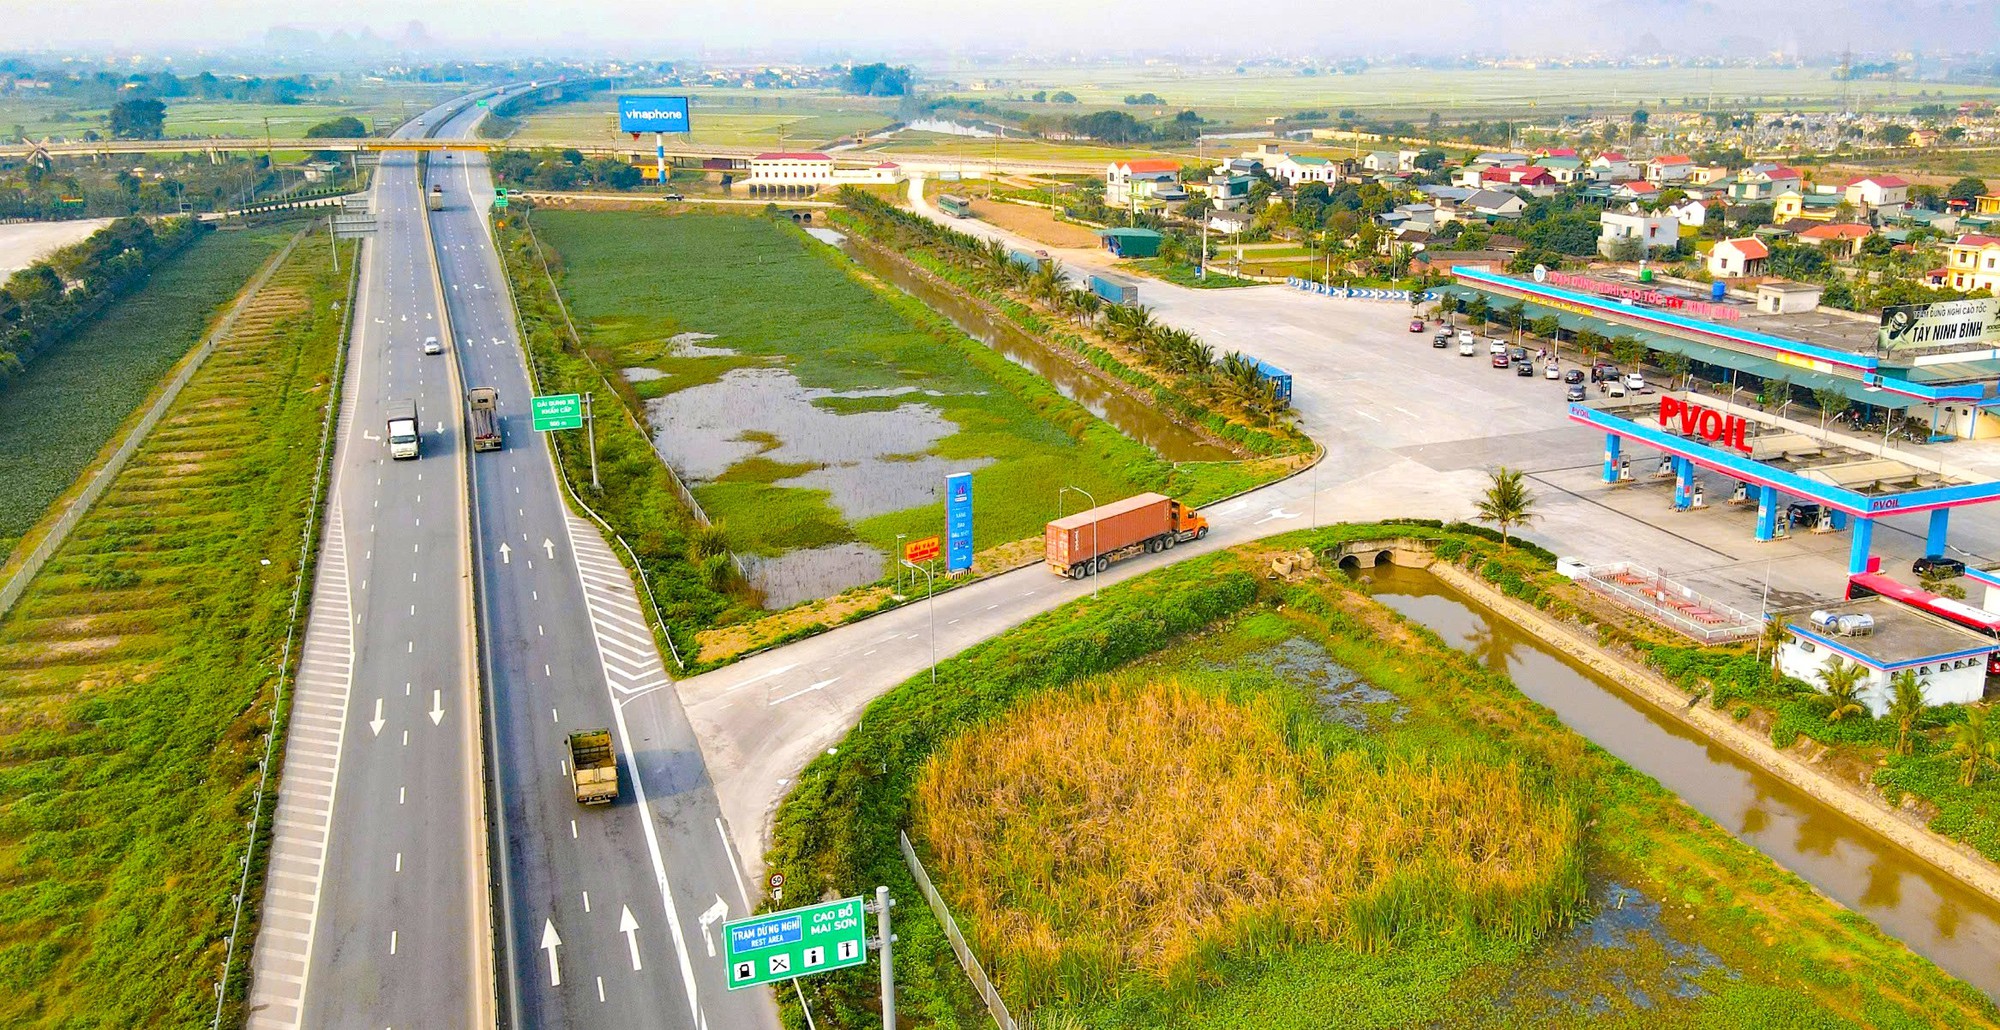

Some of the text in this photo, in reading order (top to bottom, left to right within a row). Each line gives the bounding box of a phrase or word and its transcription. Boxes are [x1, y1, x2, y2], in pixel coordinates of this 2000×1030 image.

[625, 109, 682, 120] vinaphone
[1621, 287, 1641, 300] CAO
[1913, 323, 1931, 342] TÂY
[1932, 323, 1958, 341] NINH
[1659, 396, 1753, 454] PVOIL
[1873, 499, 1899, 510] PVOIL
[773, 876, 781, 884] 50
[813, 910, 835, 923] CAO
[810, 918, 857, 935] MAI SƠN
[751, 934, 784, 947] REST AREA
